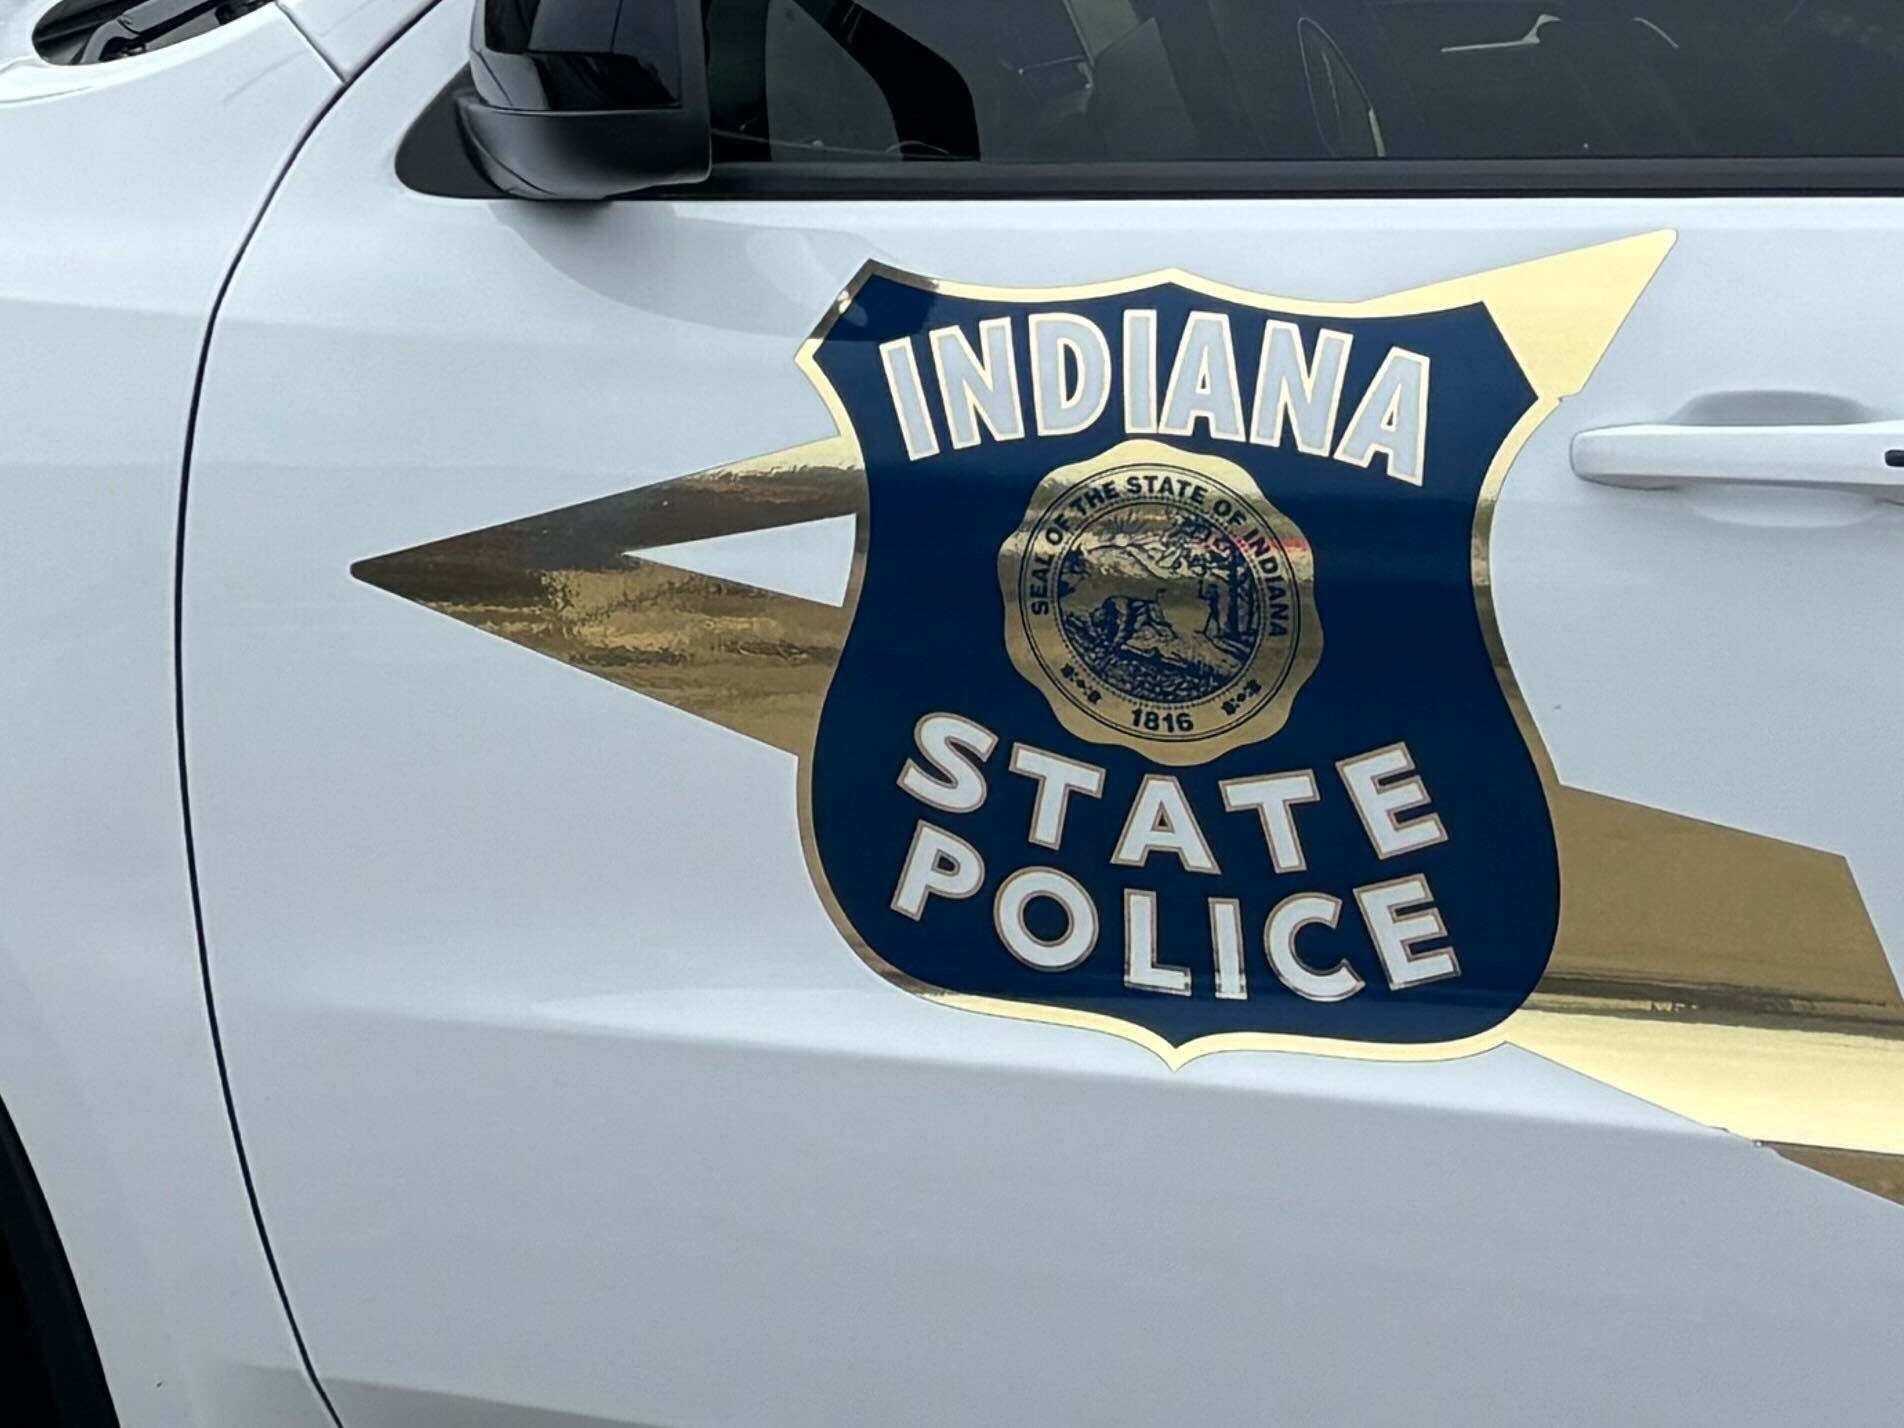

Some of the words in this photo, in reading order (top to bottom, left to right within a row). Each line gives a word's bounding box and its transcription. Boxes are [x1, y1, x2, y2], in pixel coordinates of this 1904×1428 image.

[878, 309, 1431, 488] INDIANA
[1030, 552, 1051, 617] SEAL
[1045, 512, 1074, 545] OF
[1073, 479, 1120, 515] THE
[1126, 475, 1206, 506] STATE
[1213, 499, 1249, 527] OF
[1243, 527, 1290, 638] INDIANA
[896, 711, 1449, 875] STATE
[1131, 708, 1195, 733] 1816
[890, 819, 1463, 1004] POLICE
